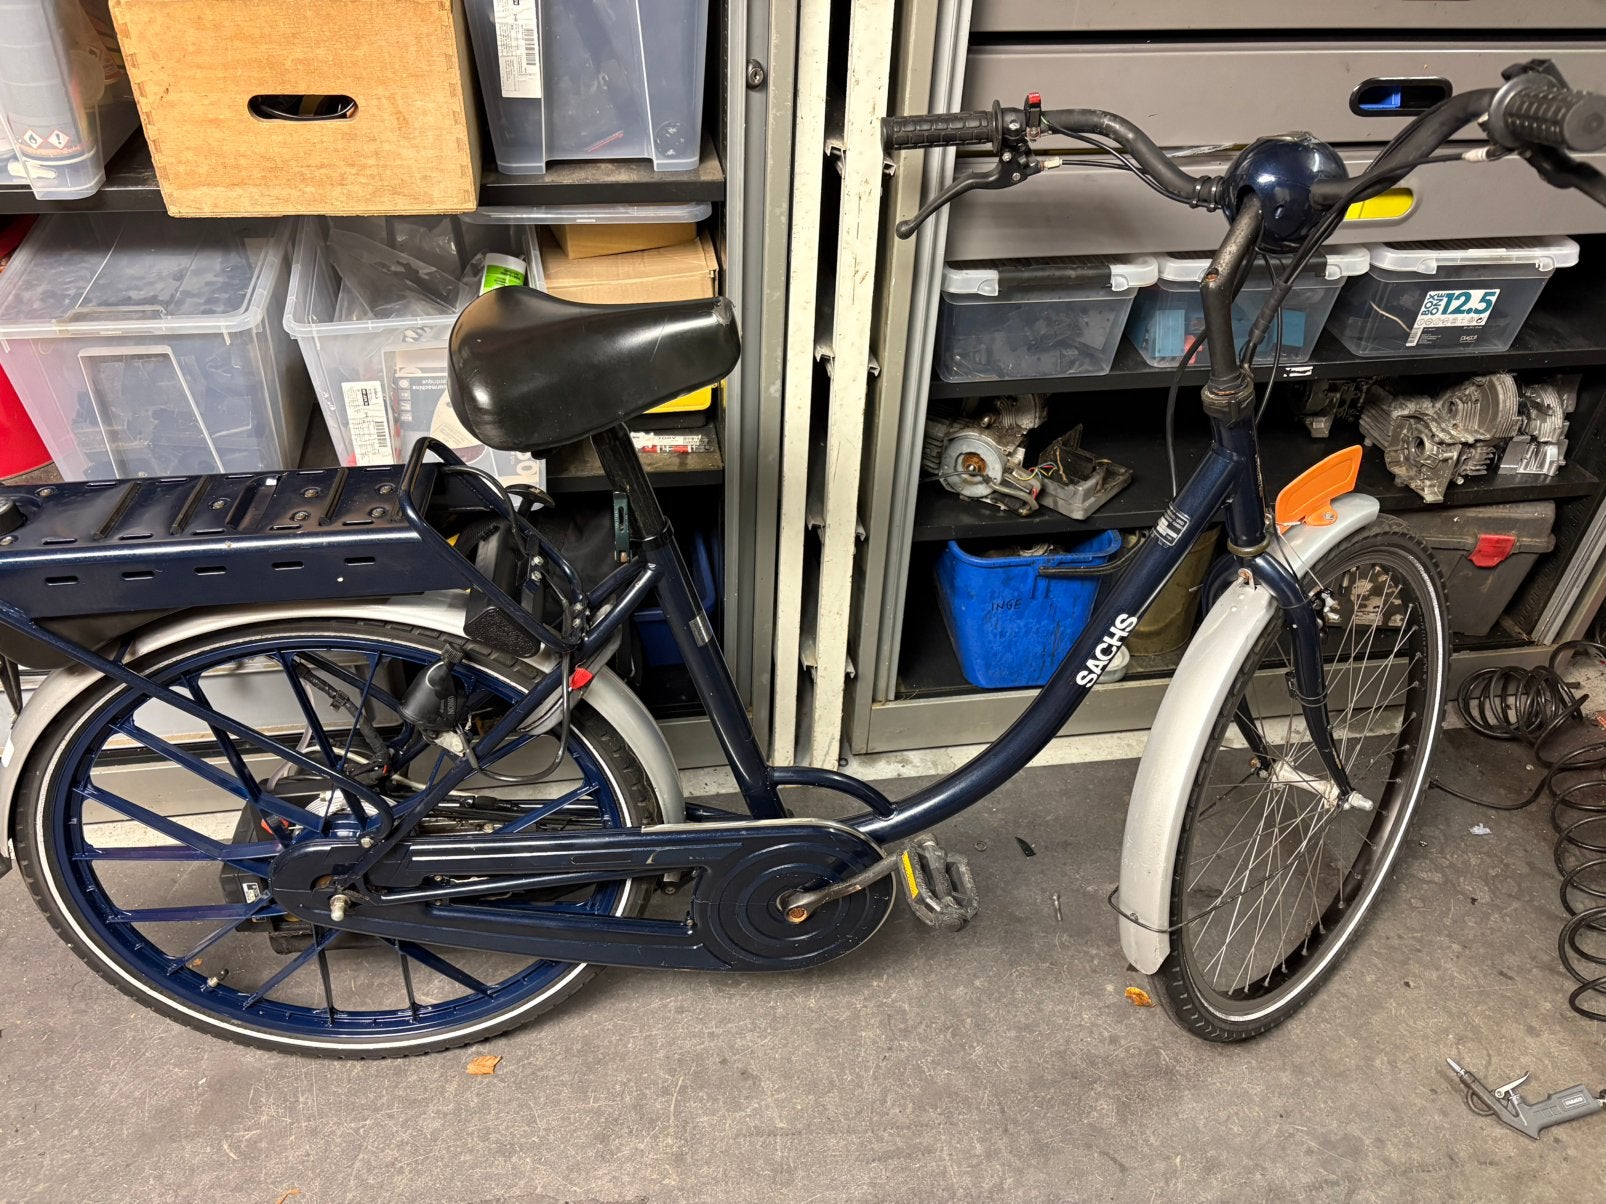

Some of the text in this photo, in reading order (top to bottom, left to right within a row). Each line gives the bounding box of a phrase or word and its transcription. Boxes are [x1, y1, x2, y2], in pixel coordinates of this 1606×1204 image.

[1421, 293, 1438, 316] BOX
[1429, 292, 1446, 316] ONE
[1440, 291, 1497, 315] 12.5
[991, 598, 1022, 611] INGE
[1076, 613, 1138, 688] SACHS
[447, 695, 456, 715] UNION
